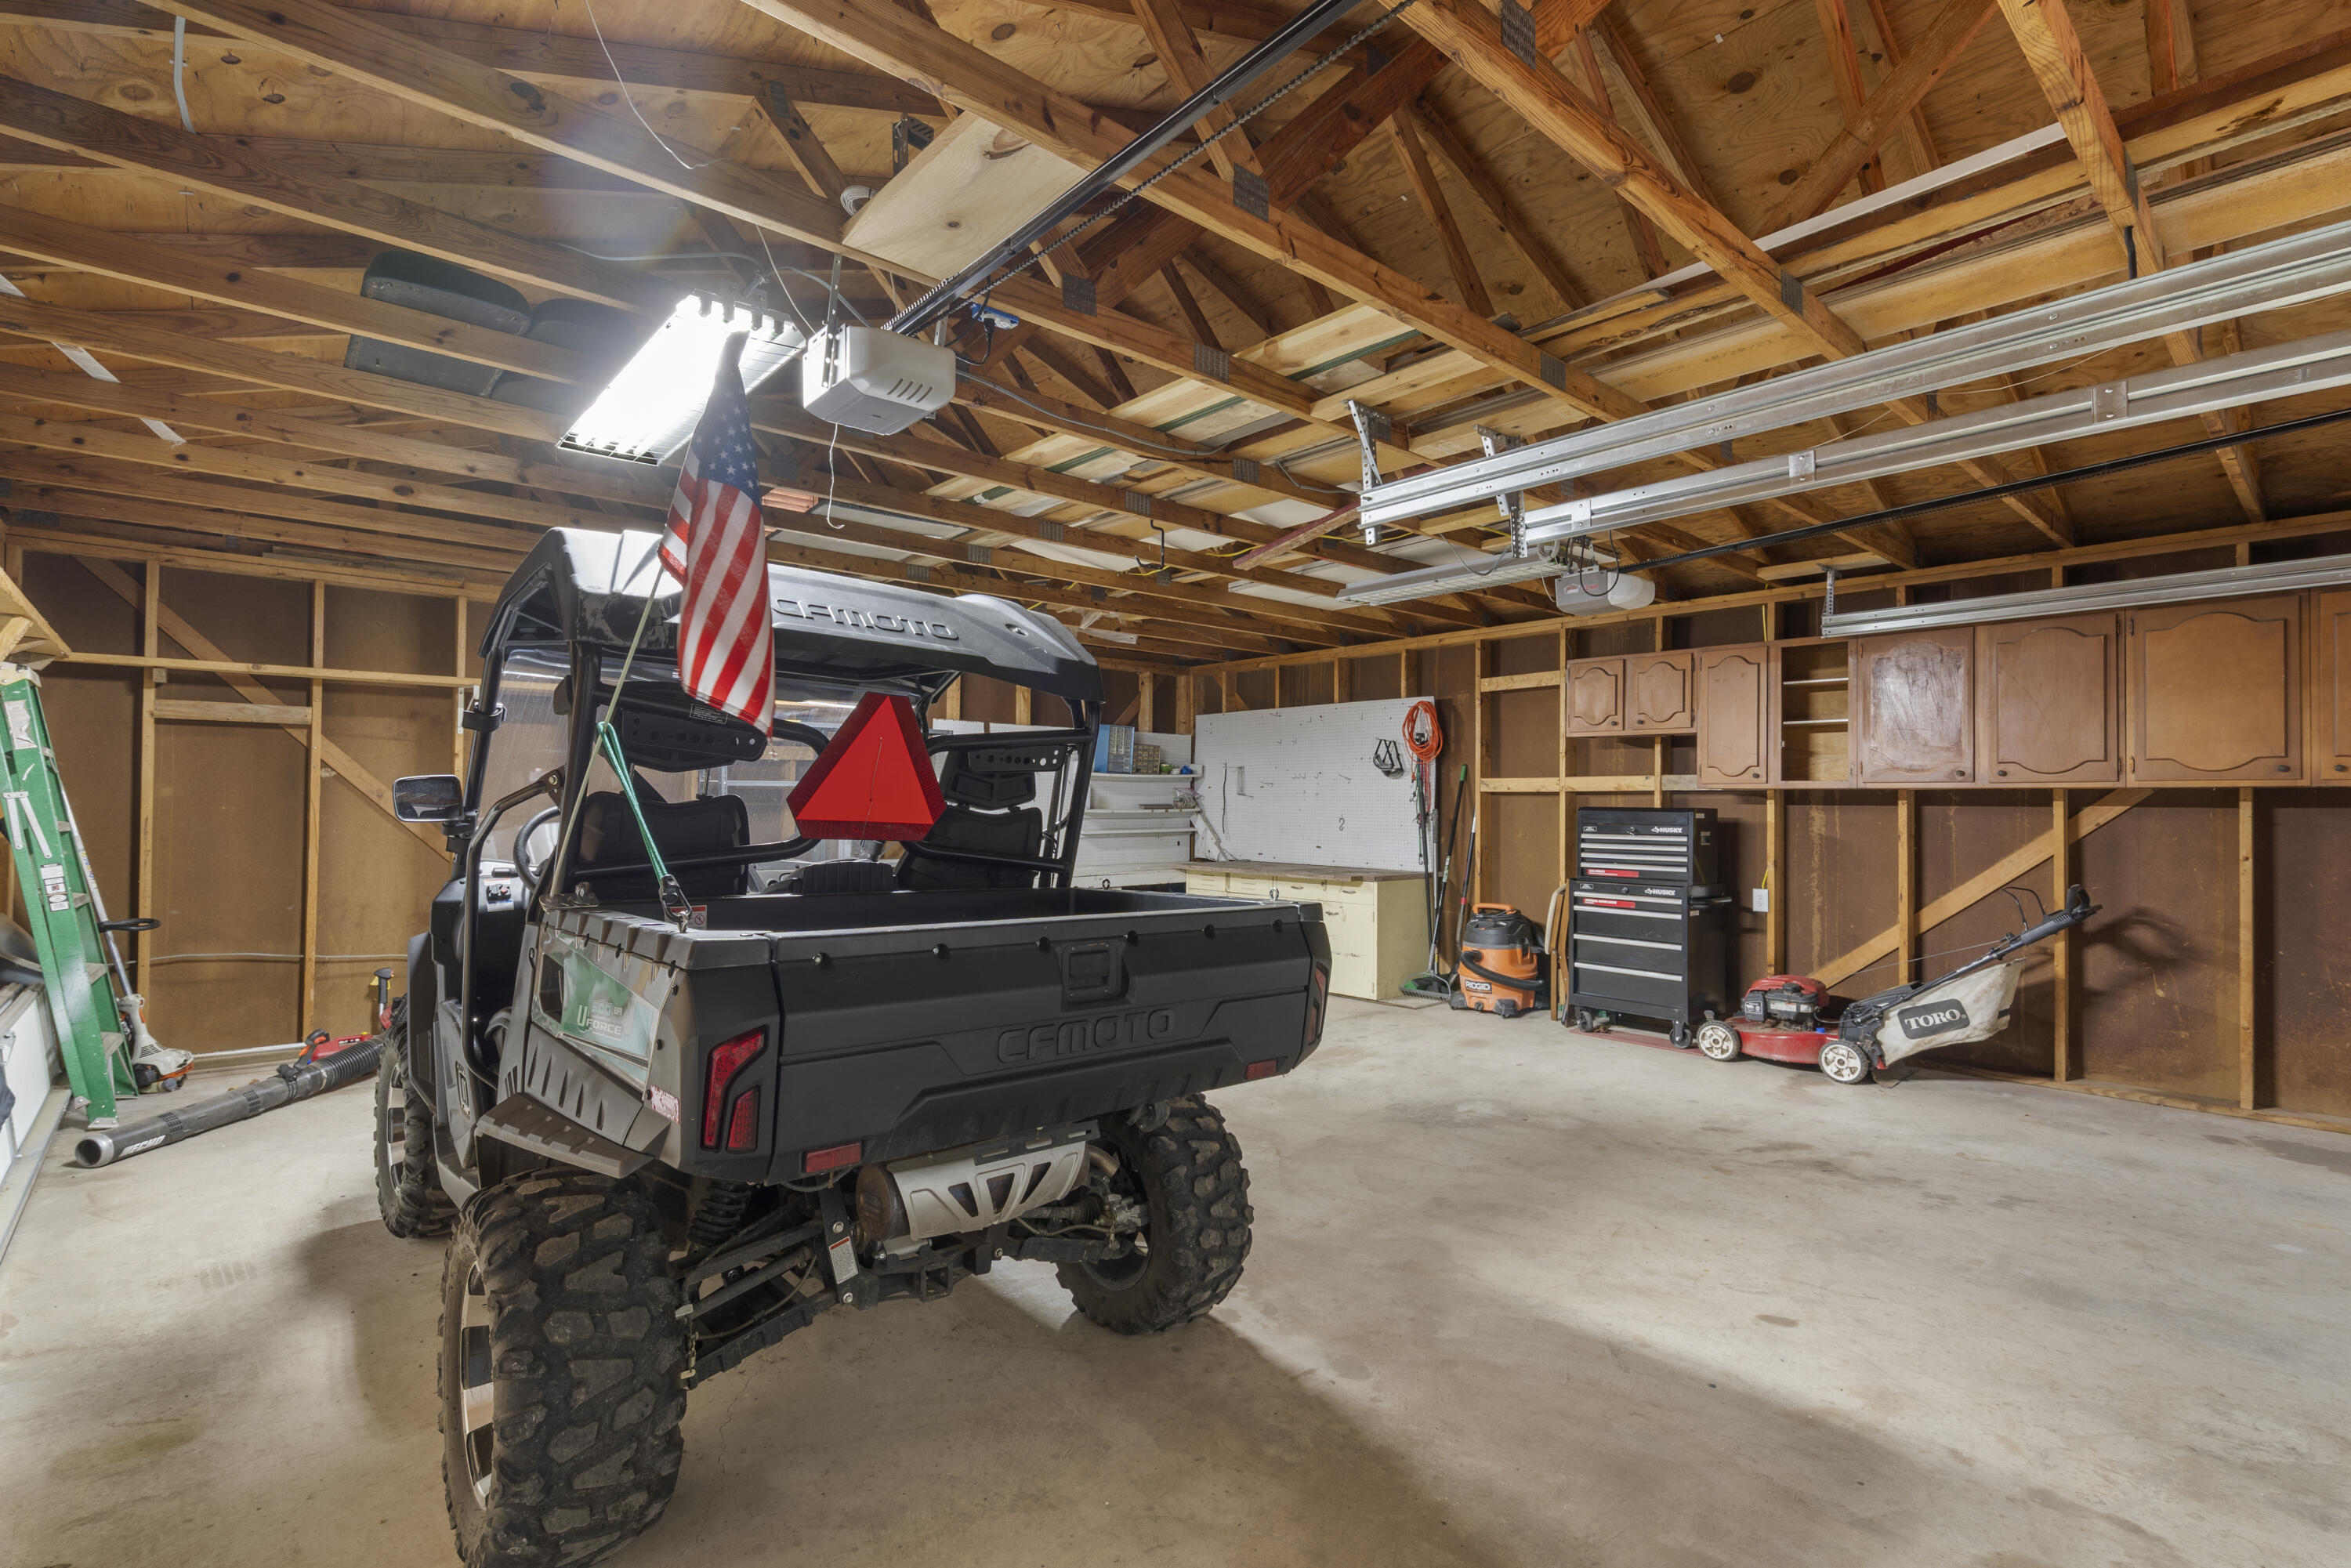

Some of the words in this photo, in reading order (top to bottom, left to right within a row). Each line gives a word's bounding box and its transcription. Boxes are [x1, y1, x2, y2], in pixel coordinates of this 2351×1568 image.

[772, 599, 958, 640] CFMOTO
[1465, 980, 1491, 990] RIDGID
[1904, 1009, 1961, 1030] TORO
[998, 1008, 1175, 1063] CFMOTO
[131, 1135, 166, 1153] ECHO
